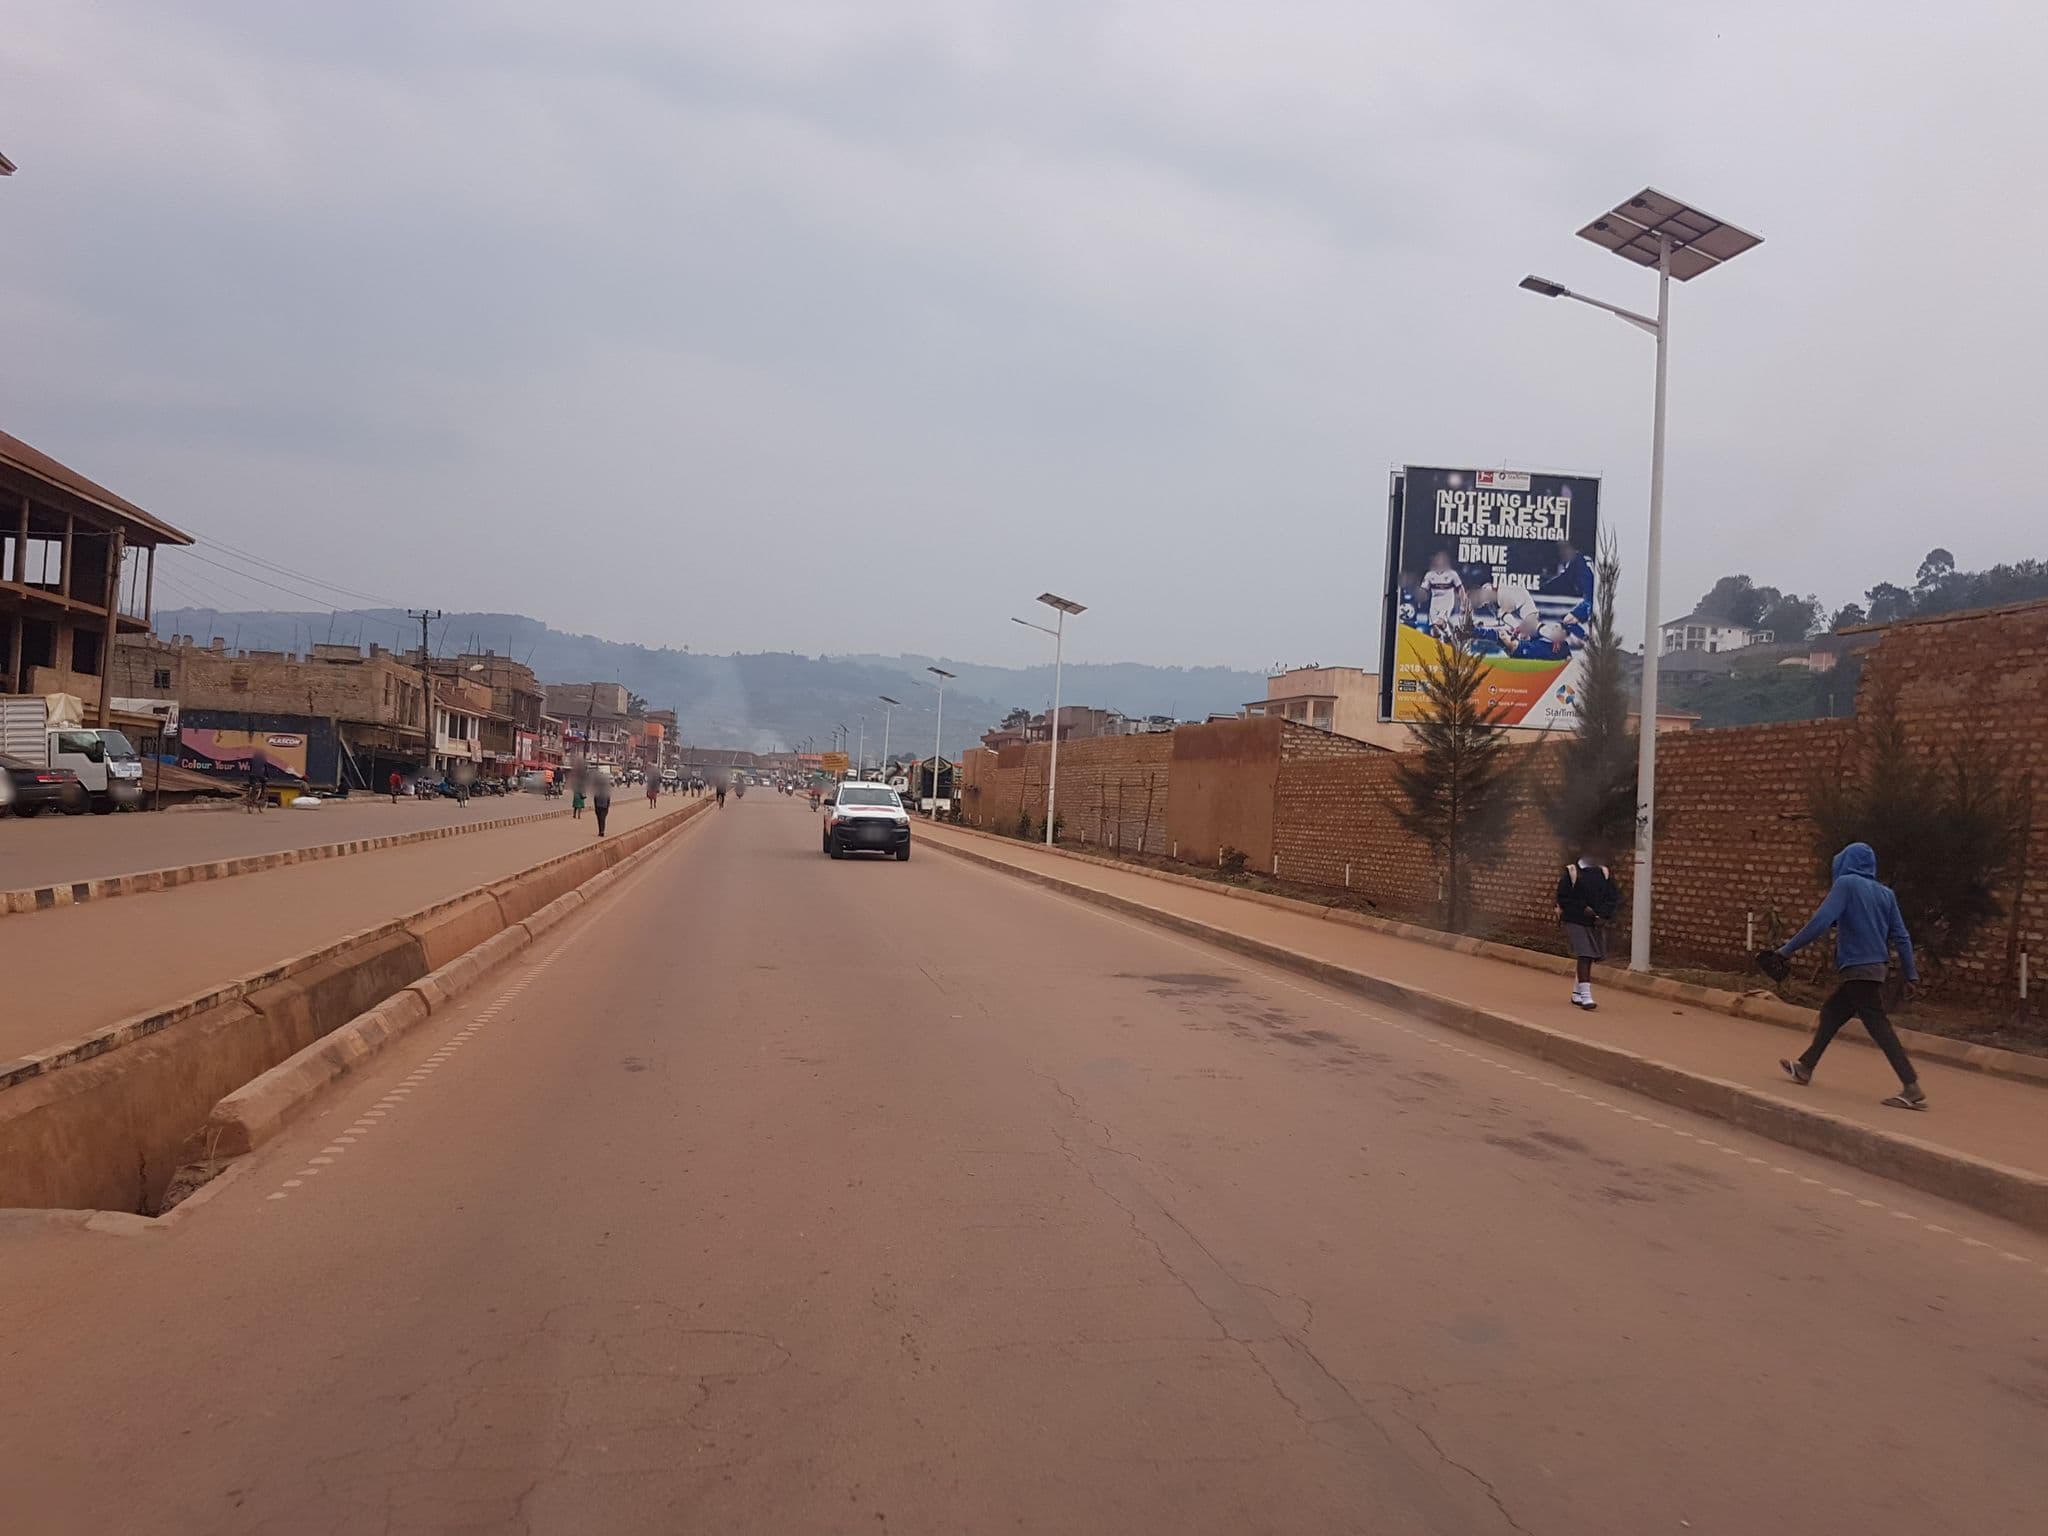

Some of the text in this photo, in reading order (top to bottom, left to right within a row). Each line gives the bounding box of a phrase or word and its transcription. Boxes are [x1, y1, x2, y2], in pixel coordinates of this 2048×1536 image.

[1440, 490, 1566, 511] NOTHING LIKE
[1440, 503, 1566, 529] THE REST
[1440, 521, 1565, 541] THIS IS BUNDESLIGA
[1458, 544, 1508, 565] DRIVE
[1491, 573, 1540, 591] TACKLE
[181, 759, 212, 770] Colour
[215, 761, 235, 770] Your
